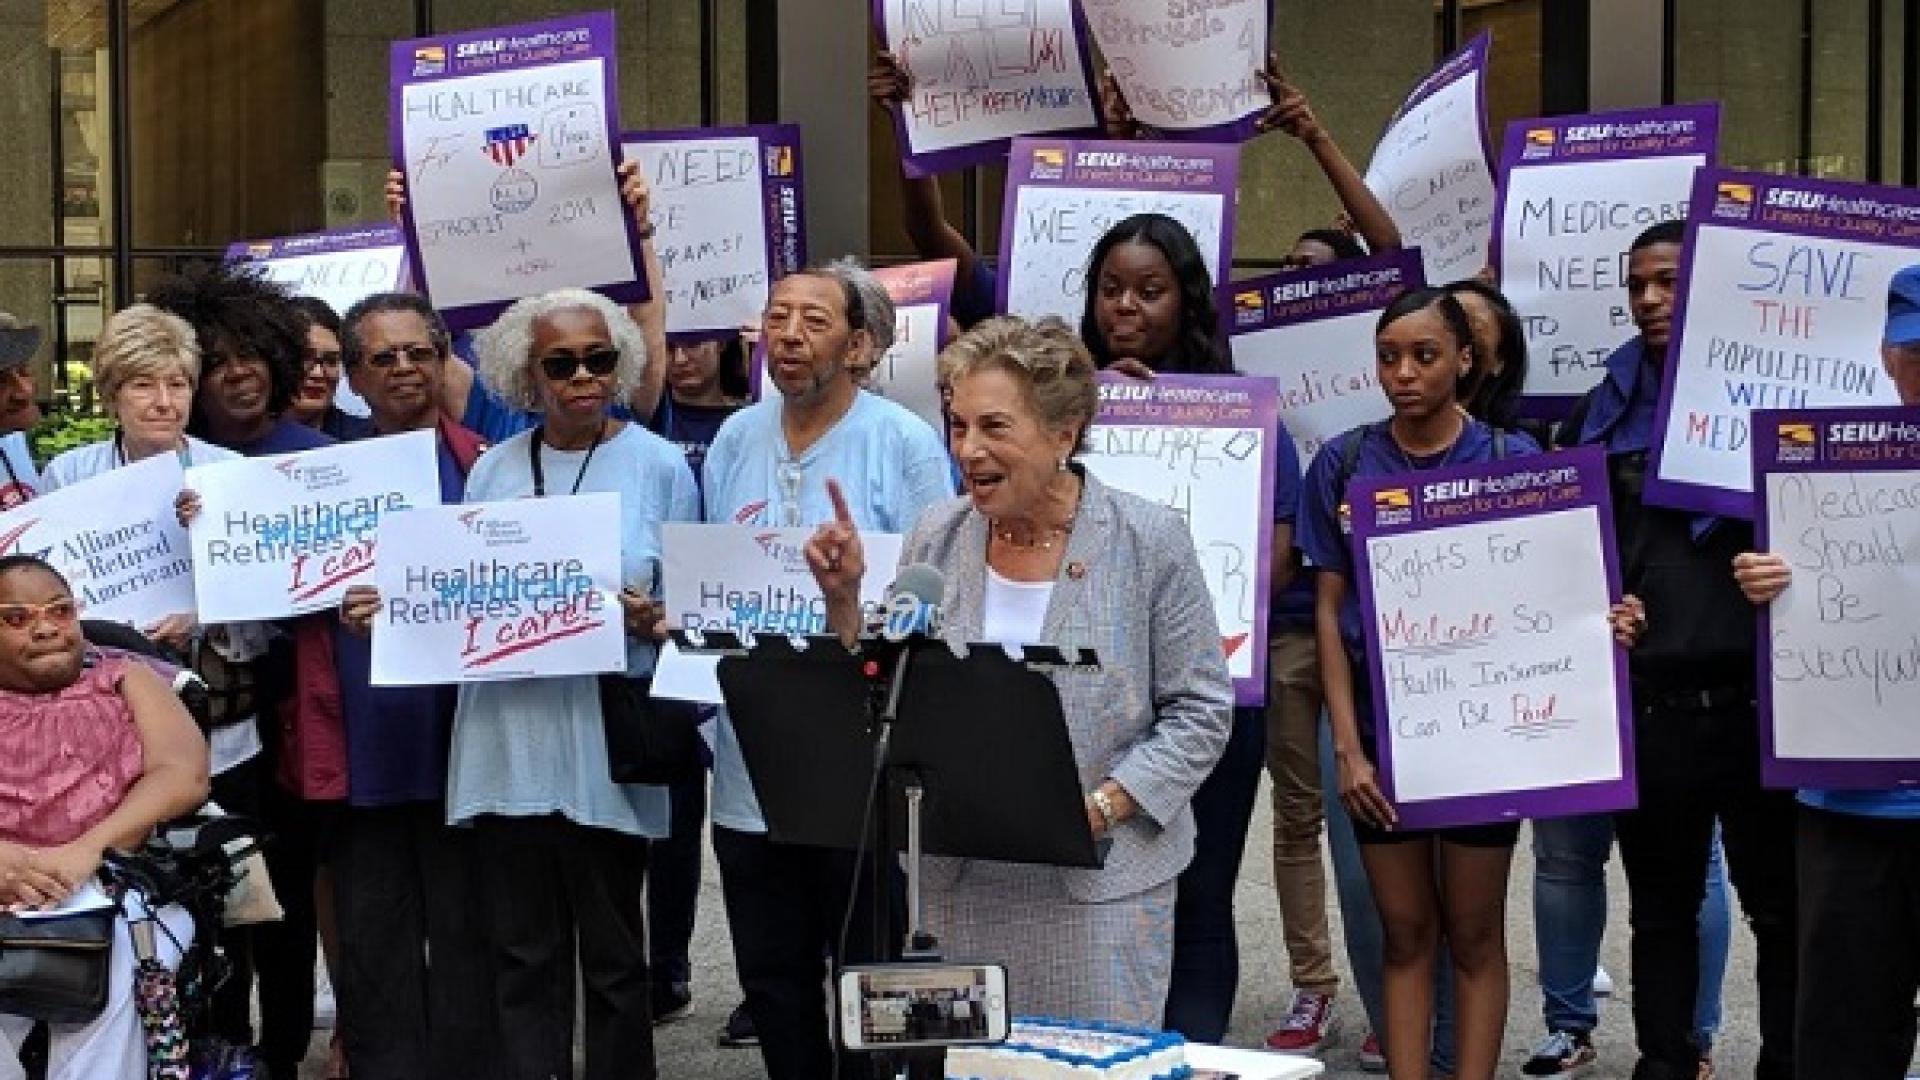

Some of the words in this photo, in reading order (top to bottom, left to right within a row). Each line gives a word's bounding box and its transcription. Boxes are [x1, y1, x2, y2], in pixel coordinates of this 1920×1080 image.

[406, 78, 590, 121] HEALTHCARE
[656, 150, 755, 185] NEED
[1028, 208, 1077, 244] WE
[1737, 241, 1872, 302] SAVE
[1521, 315, 1559, 341] TO
[1752, 299, 1820, 339] THE
[1549, 345, 1610, 377] FAI
[1706, 335, 1878, 396] POPULATION
[1724, 379, 1808, 409] WITH
[1423, 466, 1579, 503] SEIUHealthcare
[224, 492, 405, 536] Healthcare
[262, 507, 379, 545] Medica
[64, 520, 153, 565] Alliance
[86, 530, 170, 579] Retired
[322, 537, 375, 575] car
[1794, 521, 1904, 571] Should
[83, 559, 192, 604] American
[406, 559, 583, 592] Healthcare
[1373, 541, 1467, 598] Rights
[389, 595, 522, 625] Retirees
[441, 574, 593, 607] Medicare
[1818, 574, 1885, 624] Be
[461, 616, 483, 657] I
[1388, 660, 1456, 699] Health
[1469, 655, 1575, 687] Insurance
[1398, 715, 1441, 739] Can
[1511, 692, 1557, 723] Paid
